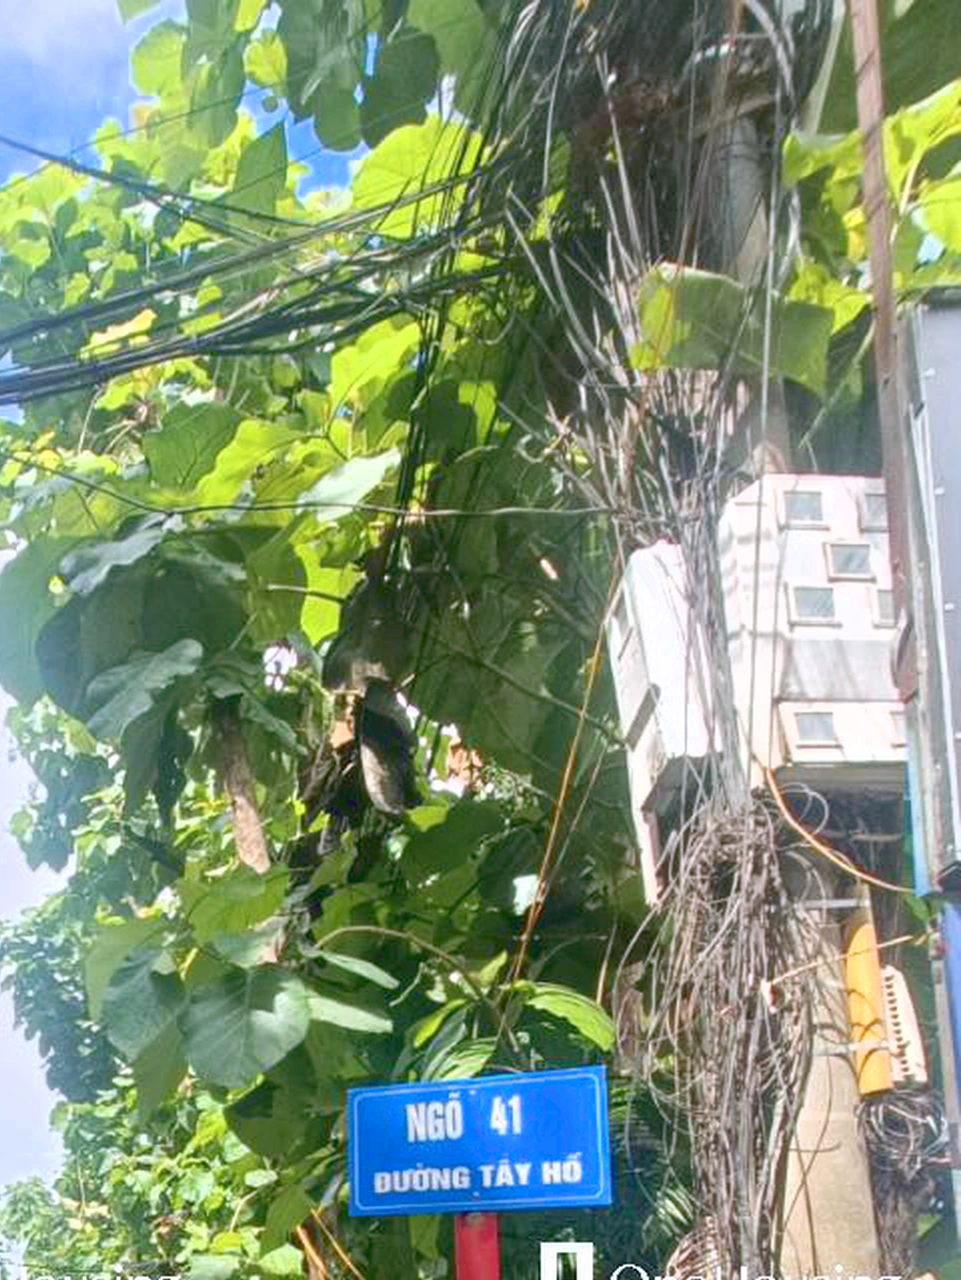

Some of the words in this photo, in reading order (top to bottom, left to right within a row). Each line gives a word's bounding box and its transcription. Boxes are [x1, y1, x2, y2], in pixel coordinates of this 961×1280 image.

[406, 1091, 463, 1143] NGÕ
[491, 1094, 522, 1136] 41
[374, 1162, 471, 1194] ĐƯỜNG
[480, 1158, 532, 1187] TÂY
